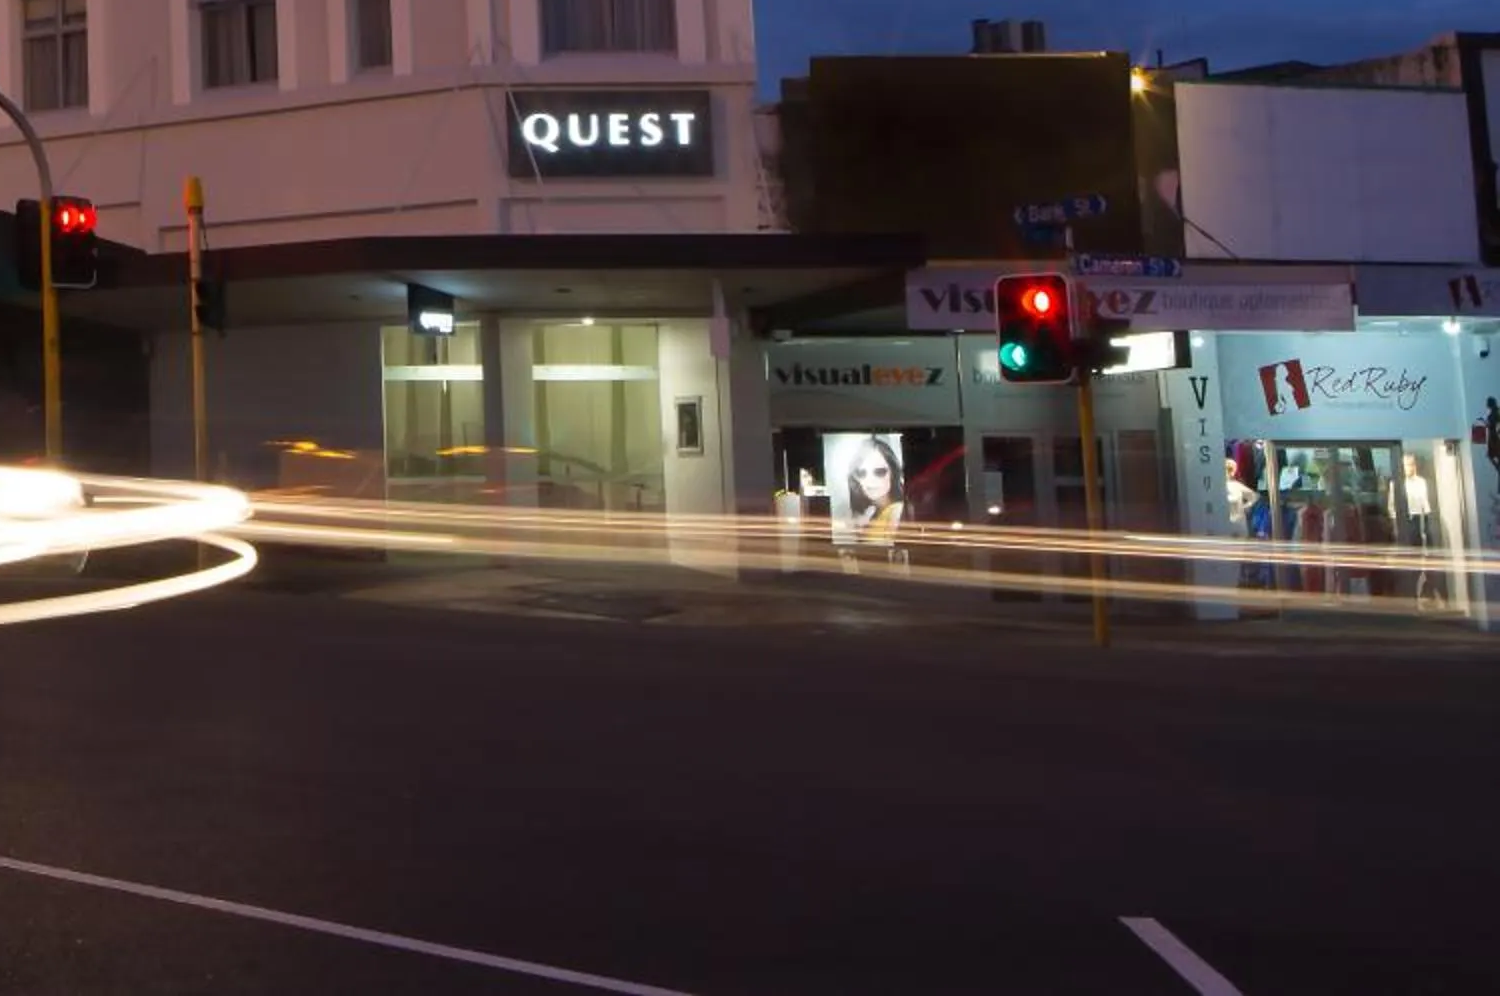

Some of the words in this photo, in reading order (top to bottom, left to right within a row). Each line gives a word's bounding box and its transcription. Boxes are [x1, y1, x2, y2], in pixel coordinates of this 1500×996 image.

[522, 112, 695, 153] QUEST
[920, 281, 1159, 316] visyez
[775, 362, 945, 388] visualeyez
[1306, 366, 1356, 398] Red
[1360, 367, 1428, 411] Ruby
